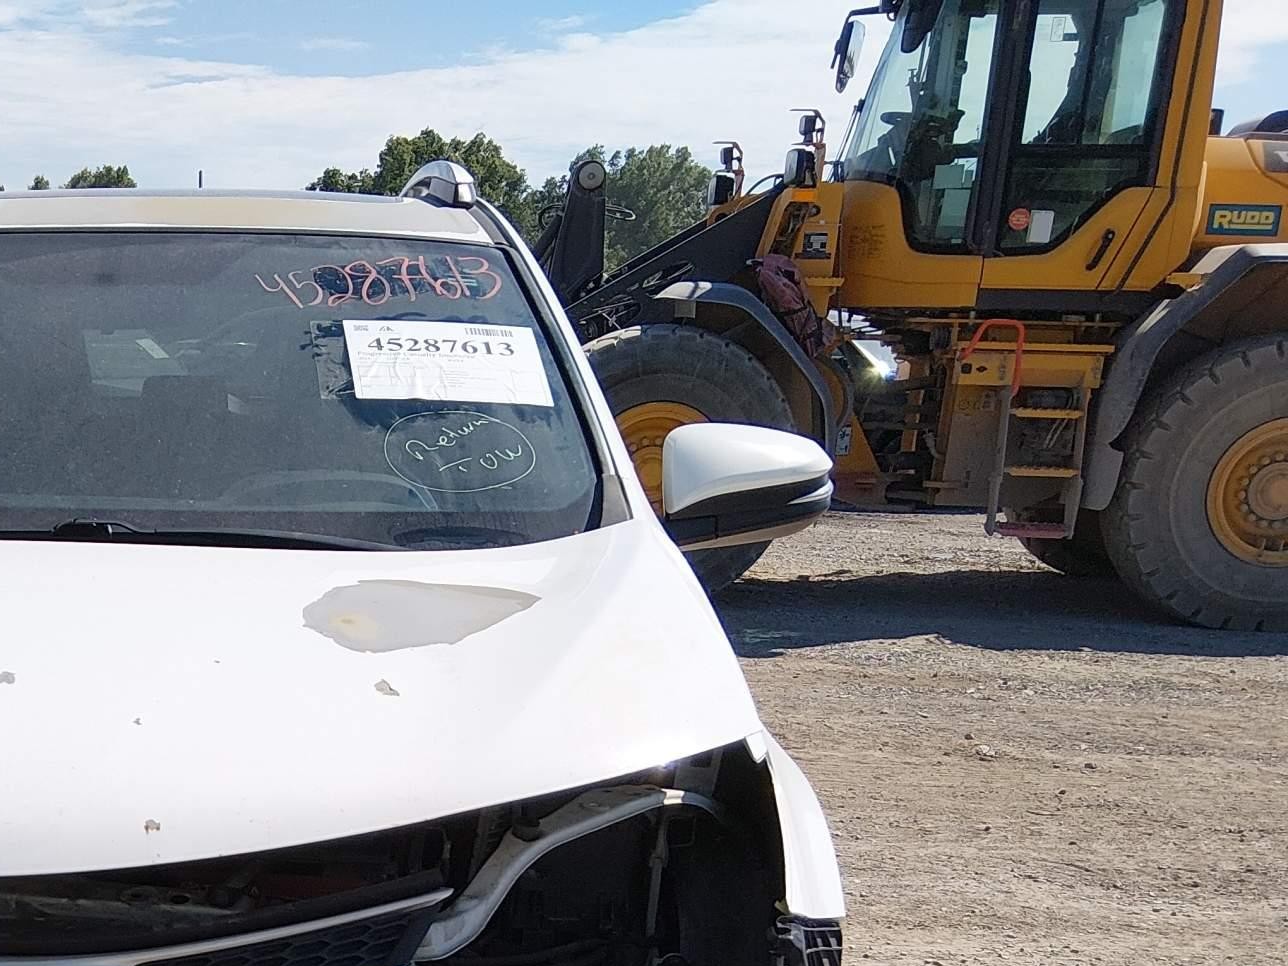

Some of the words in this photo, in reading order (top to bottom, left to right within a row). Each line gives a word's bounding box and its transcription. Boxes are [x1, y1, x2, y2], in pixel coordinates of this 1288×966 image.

[1213, 210, 1274, 229] RUDD
[254, 256, 501, 309] 45287613
[368, 337, 514, 356] 45287613
